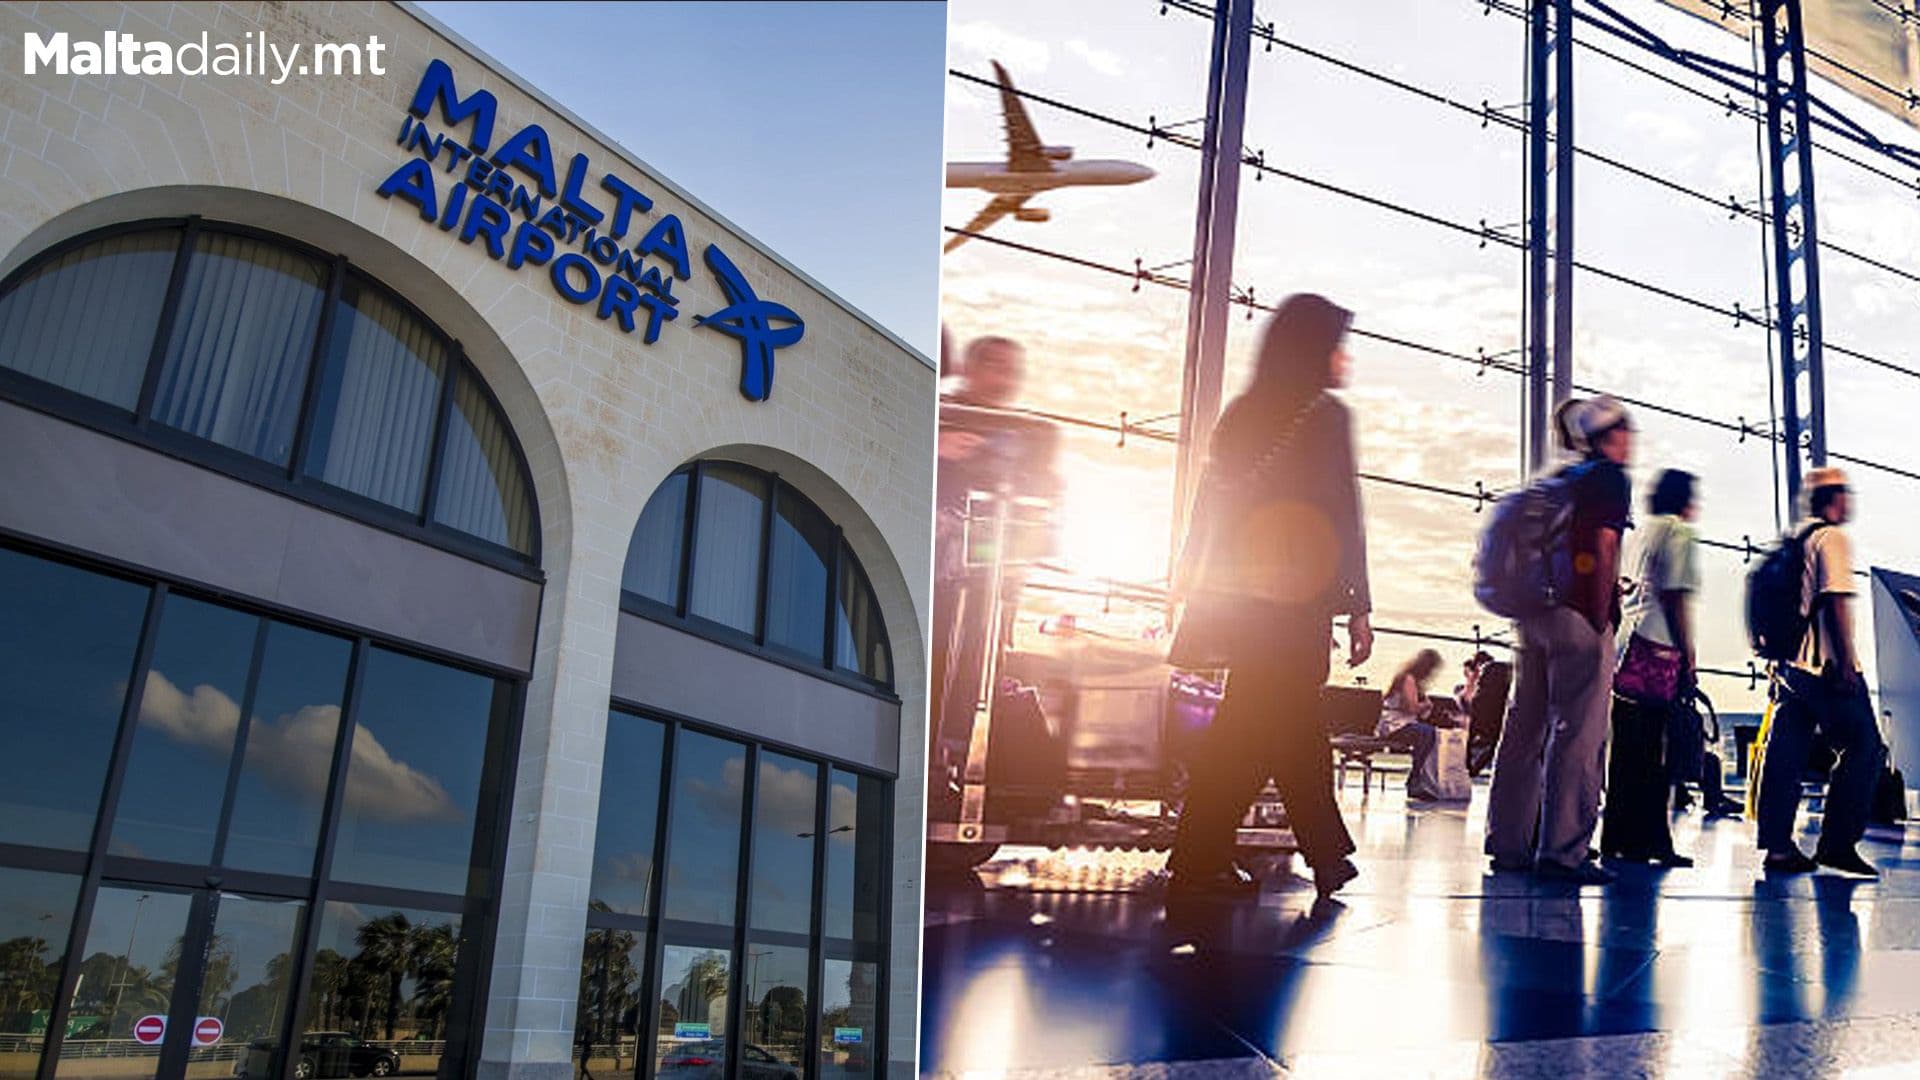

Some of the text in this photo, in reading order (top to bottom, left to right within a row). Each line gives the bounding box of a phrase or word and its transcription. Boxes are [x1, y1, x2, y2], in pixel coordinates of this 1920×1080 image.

[375, 157, 680, 344] AIRPORT
[397, 115, 680, 305] INTERNATIONAL
[408, 58, 691, 281] MALTA
